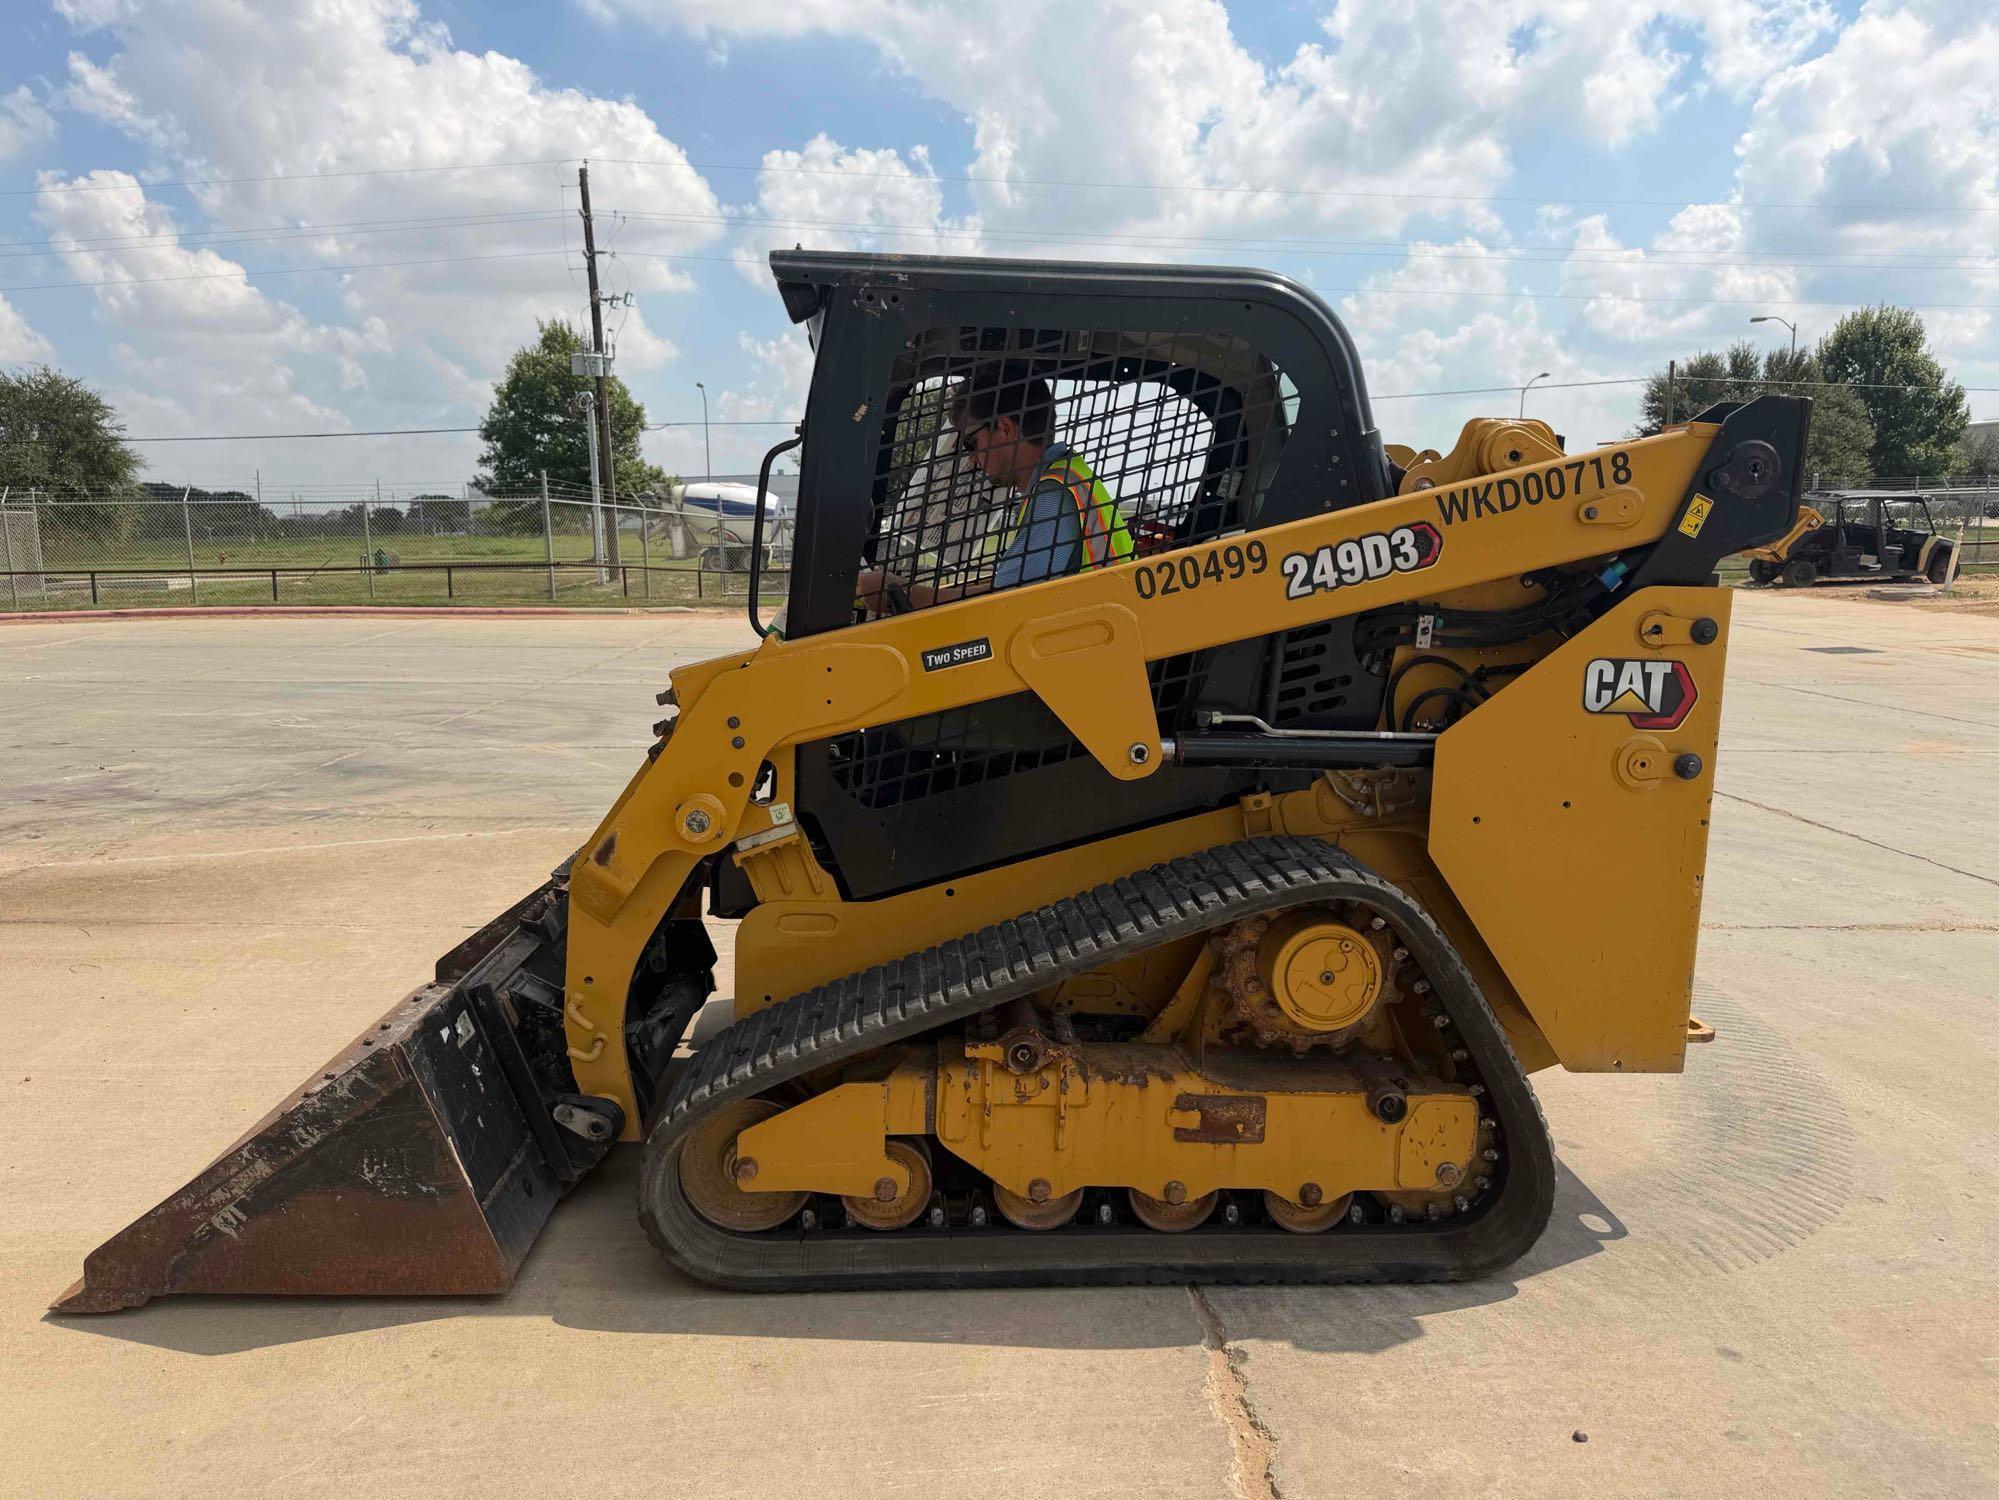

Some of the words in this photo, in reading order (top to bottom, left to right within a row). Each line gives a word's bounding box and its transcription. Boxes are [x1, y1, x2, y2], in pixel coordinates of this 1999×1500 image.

[1435, 452, 1632, 525] WKD00718
[1134, 540, 1268, 600] 020499
[1284, 528, 1420, 598] 249D3
[1584, 660, 1672, 713] CAT
